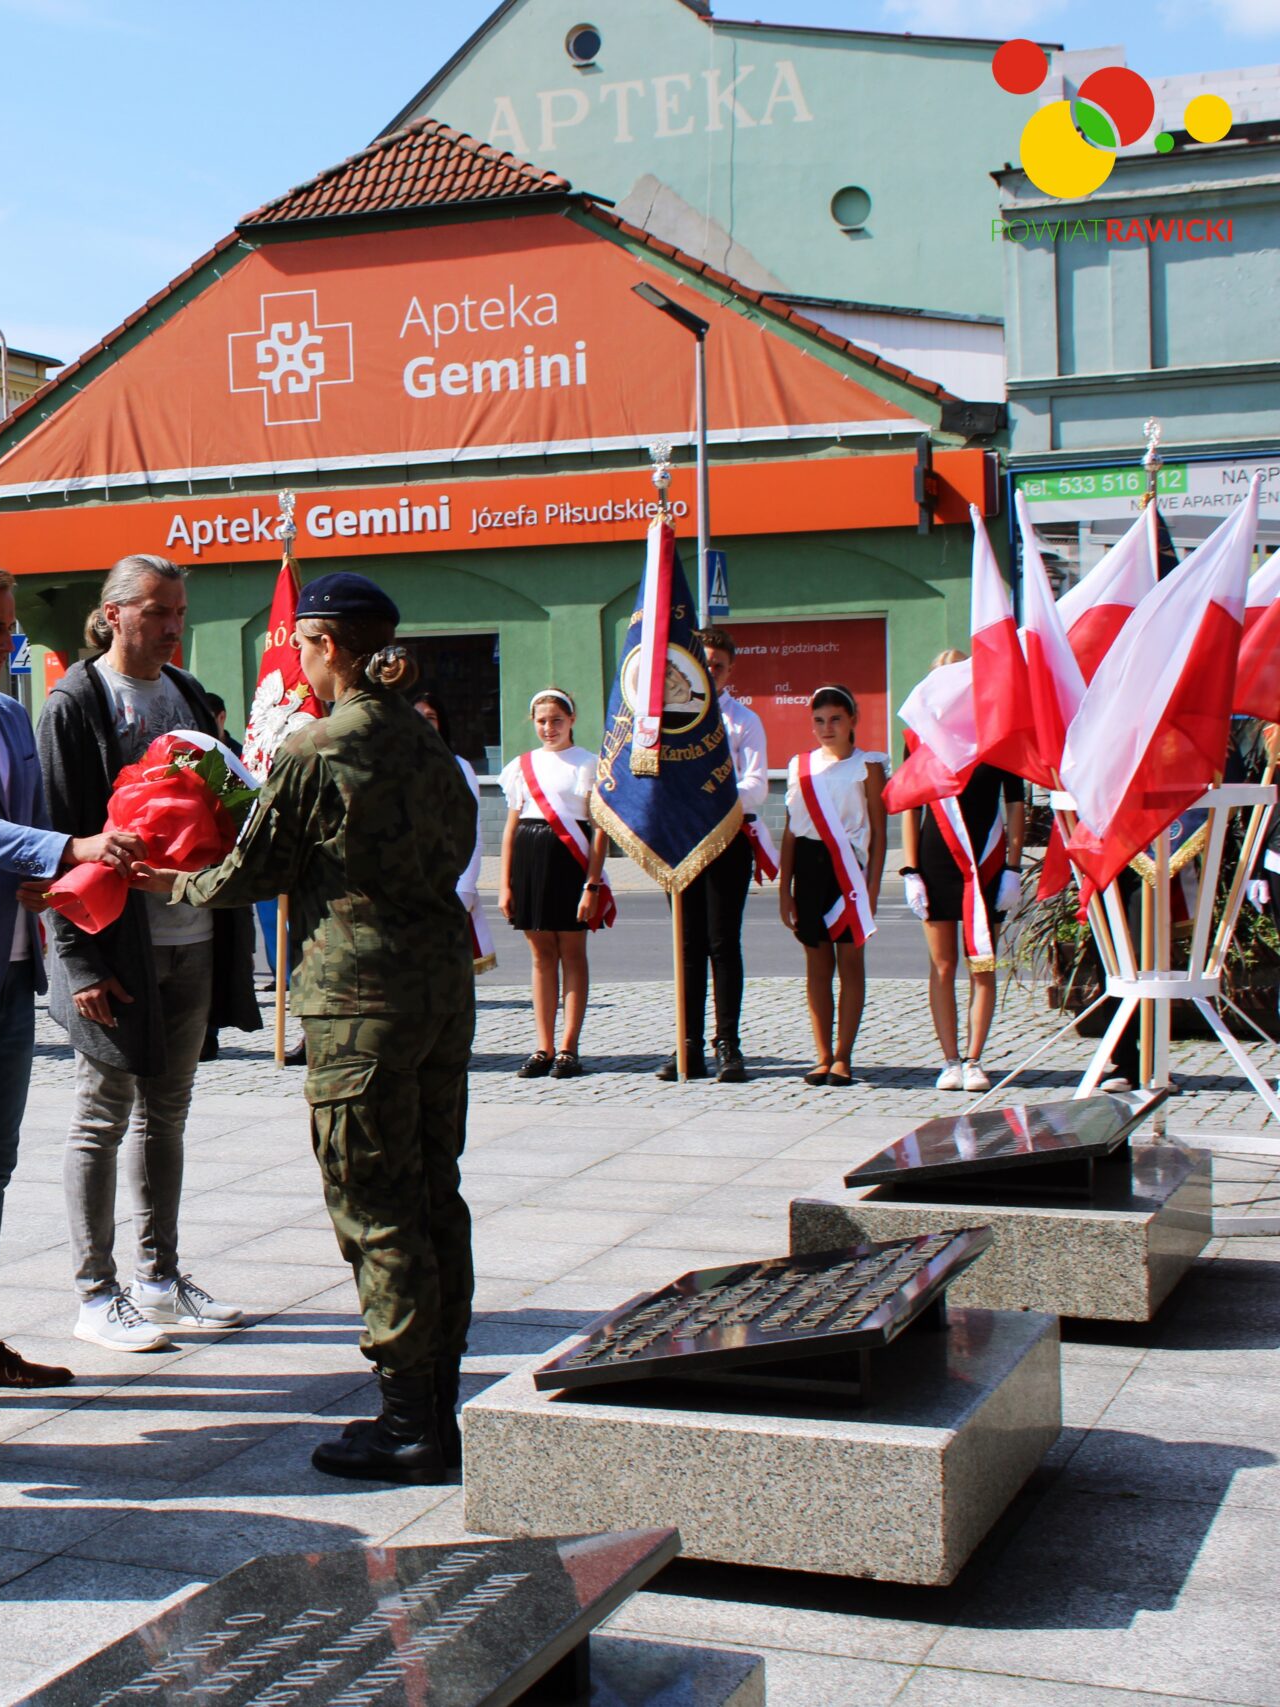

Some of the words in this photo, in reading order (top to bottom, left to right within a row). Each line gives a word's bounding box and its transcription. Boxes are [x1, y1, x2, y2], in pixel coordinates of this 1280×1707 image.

[486, 59, 815, 155] APTEKA
[399, 284, 558, 349] Apteka
[403, 340, 587, 399] Gemini
[1023, 479, 1052, 496] tel.
[1059, 476, 1095, 495] 533
[1102, 473, 1139, 491] 516
[1222, 468, 1250, 484] NA
[1130, 496, 1179, 511] NWE
[1182, 490, 1280, 508] APARTAEN
[165, 508, 297, 555] Apteka
[305, 495, 451, 538] Gemini
[468, 503, 538, 533] Józefa
[769, 646, 780, 654] w
[781, 642, 840, 656] godzinach:
[774, 681, 793, 692] nd.
[224, 1611, 267, 1626] O
[281, 1607, 345, 1631] ZA
[171, 1633, 307, 1697] WALKĘ
